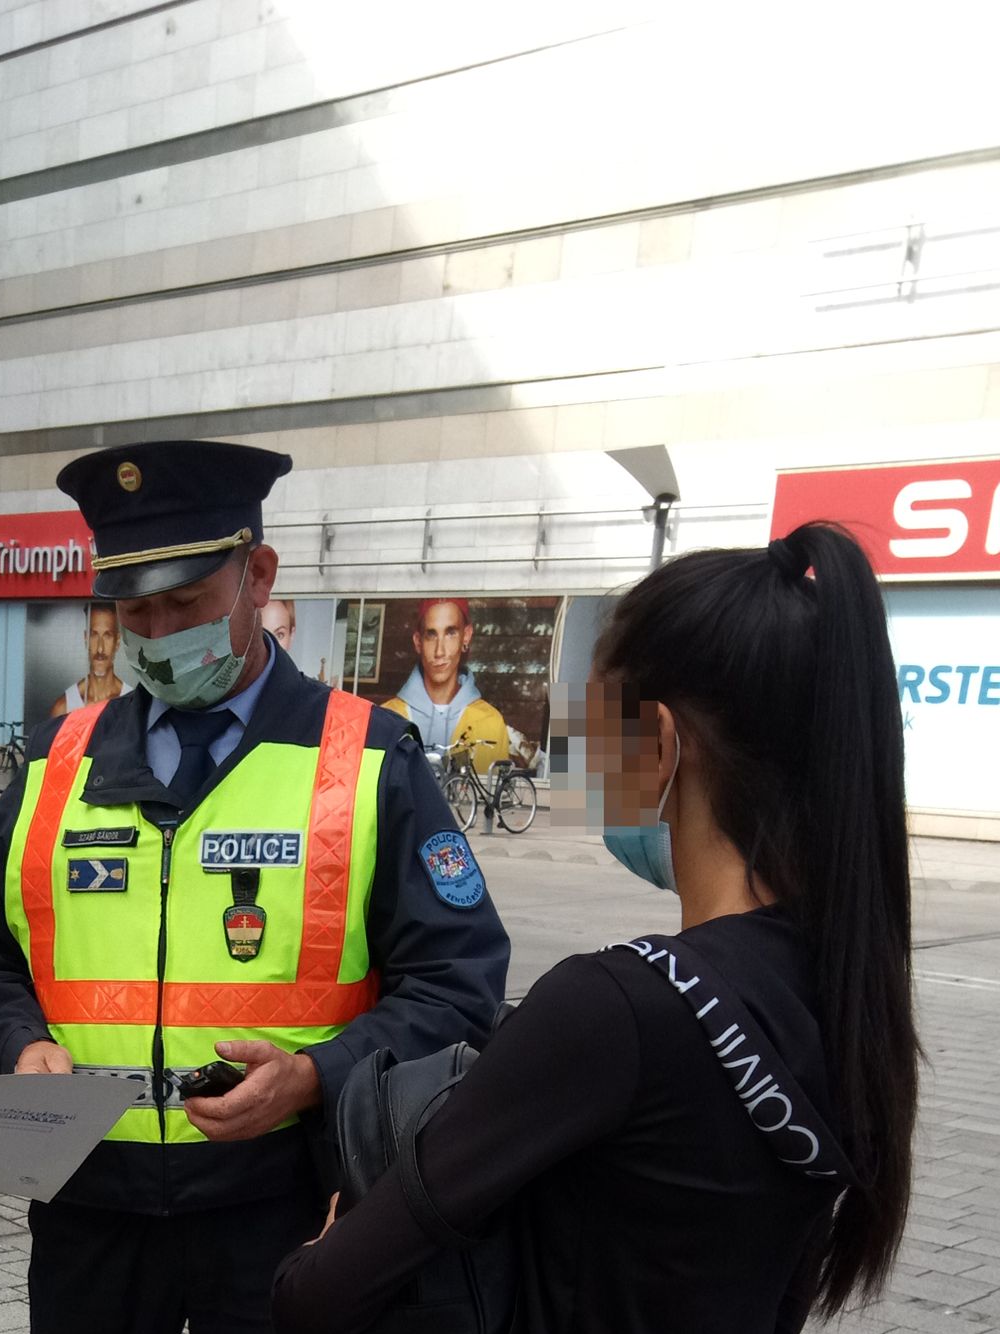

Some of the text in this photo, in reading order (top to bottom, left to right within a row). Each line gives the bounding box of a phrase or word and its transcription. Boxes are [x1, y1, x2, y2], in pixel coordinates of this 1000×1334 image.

[889, 478, 1000, 559] S
[898, 664, 1000, 705] RSTE
[203, 838, 298, 861] POLICE
[426, 833, 459, 852] POLICE
